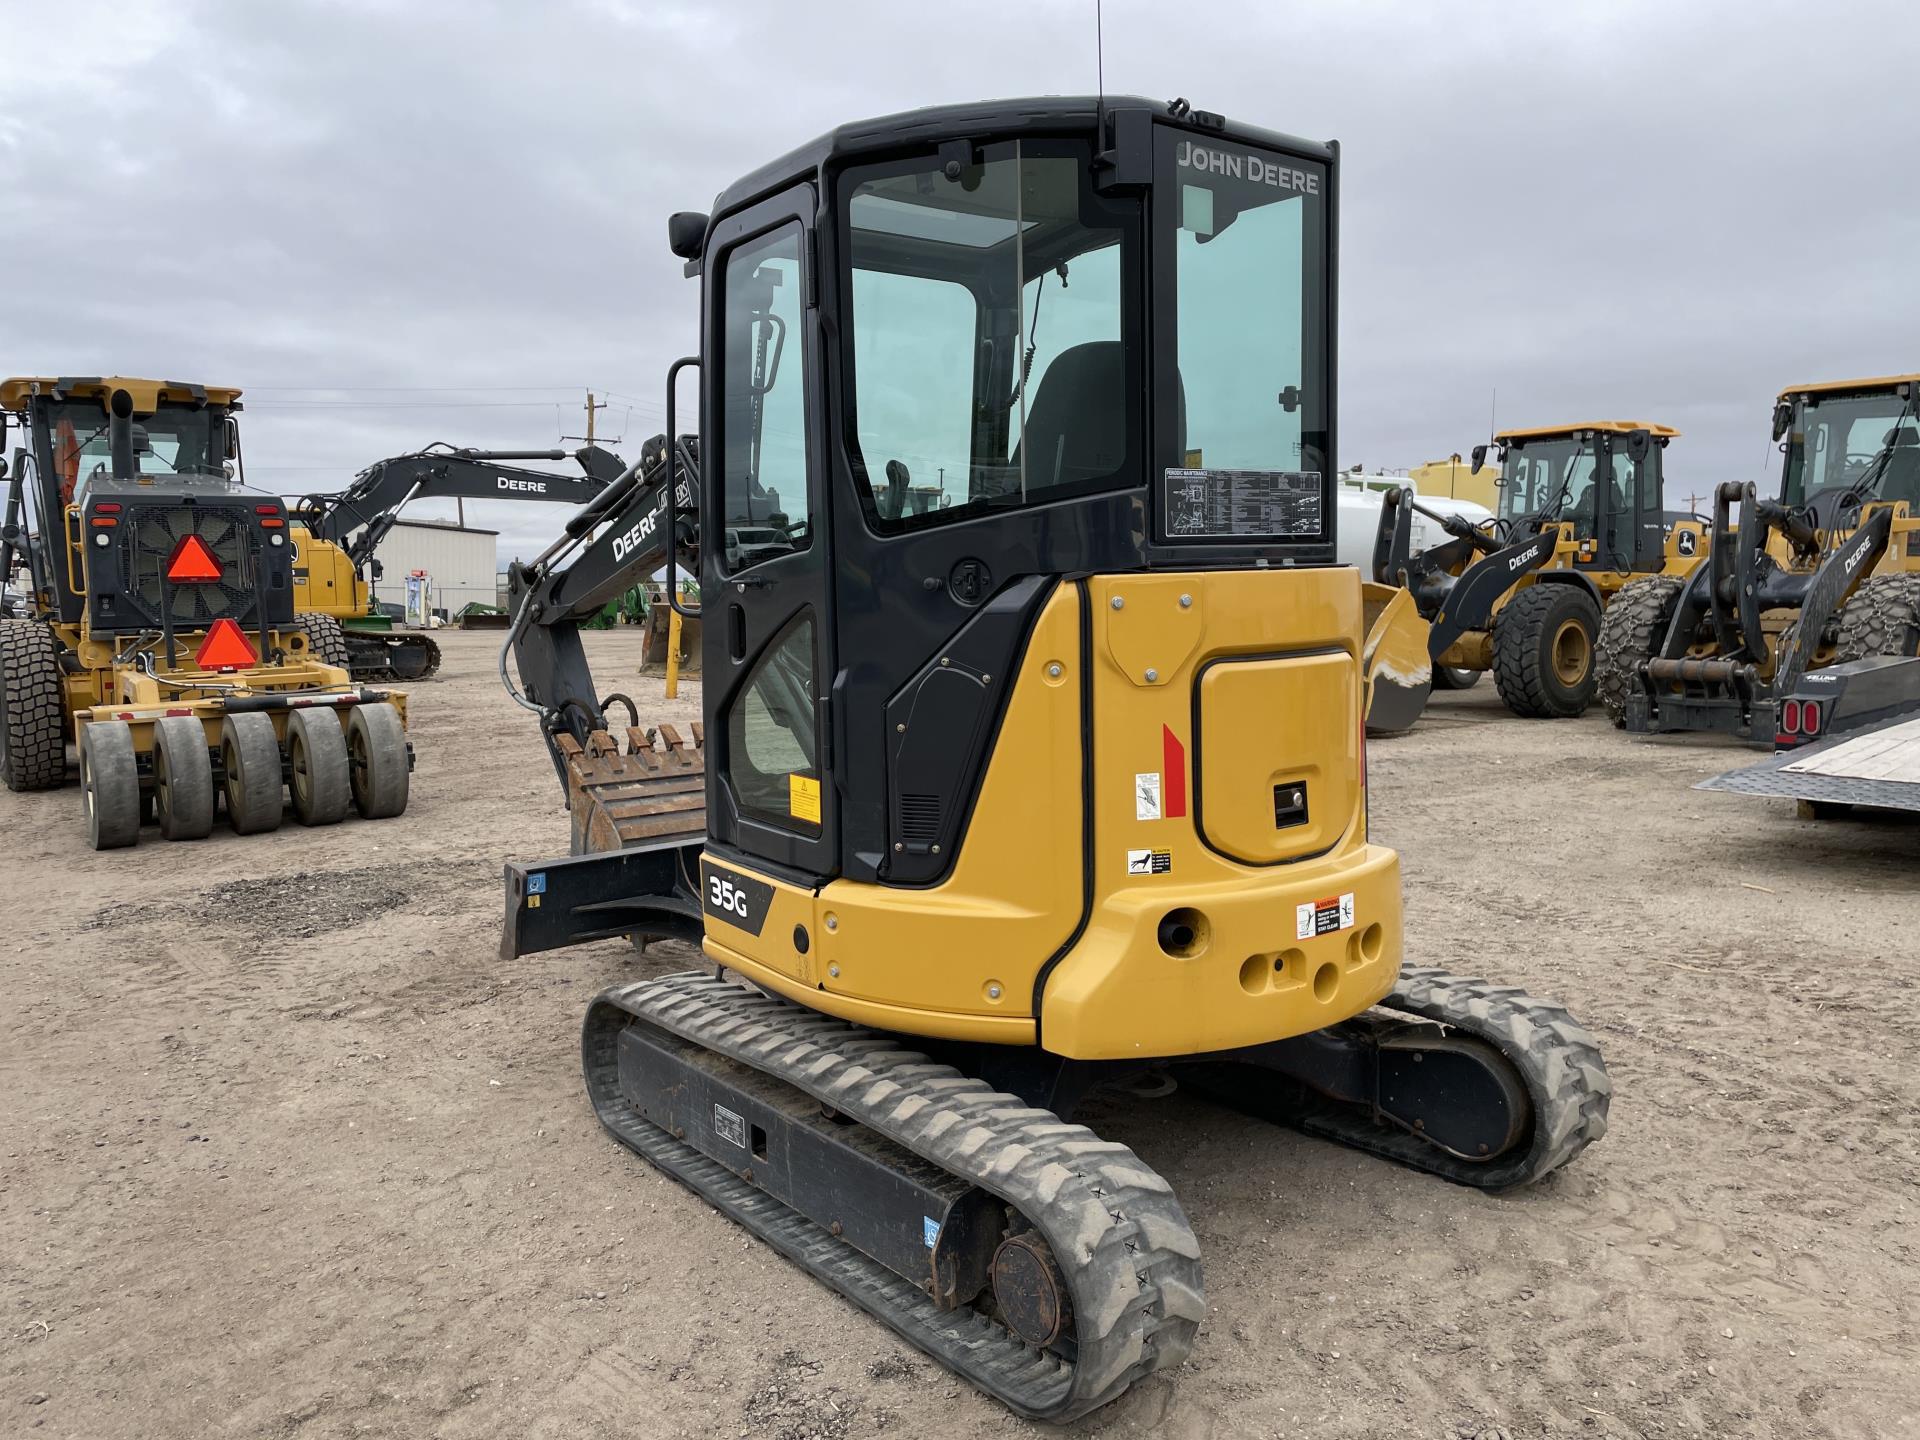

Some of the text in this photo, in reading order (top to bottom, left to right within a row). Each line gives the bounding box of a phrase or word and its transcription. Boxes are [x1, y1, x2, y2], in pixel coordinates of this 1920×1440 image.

[1178, 141, 1319, 195] JOHN DEERE
[497, 476, 547, 493] DEERE
[1508, 544, 1539, 571] DEERE
[1844, 535, 1871, 575] DEERE
[709, 875, 748, 918] 35G
